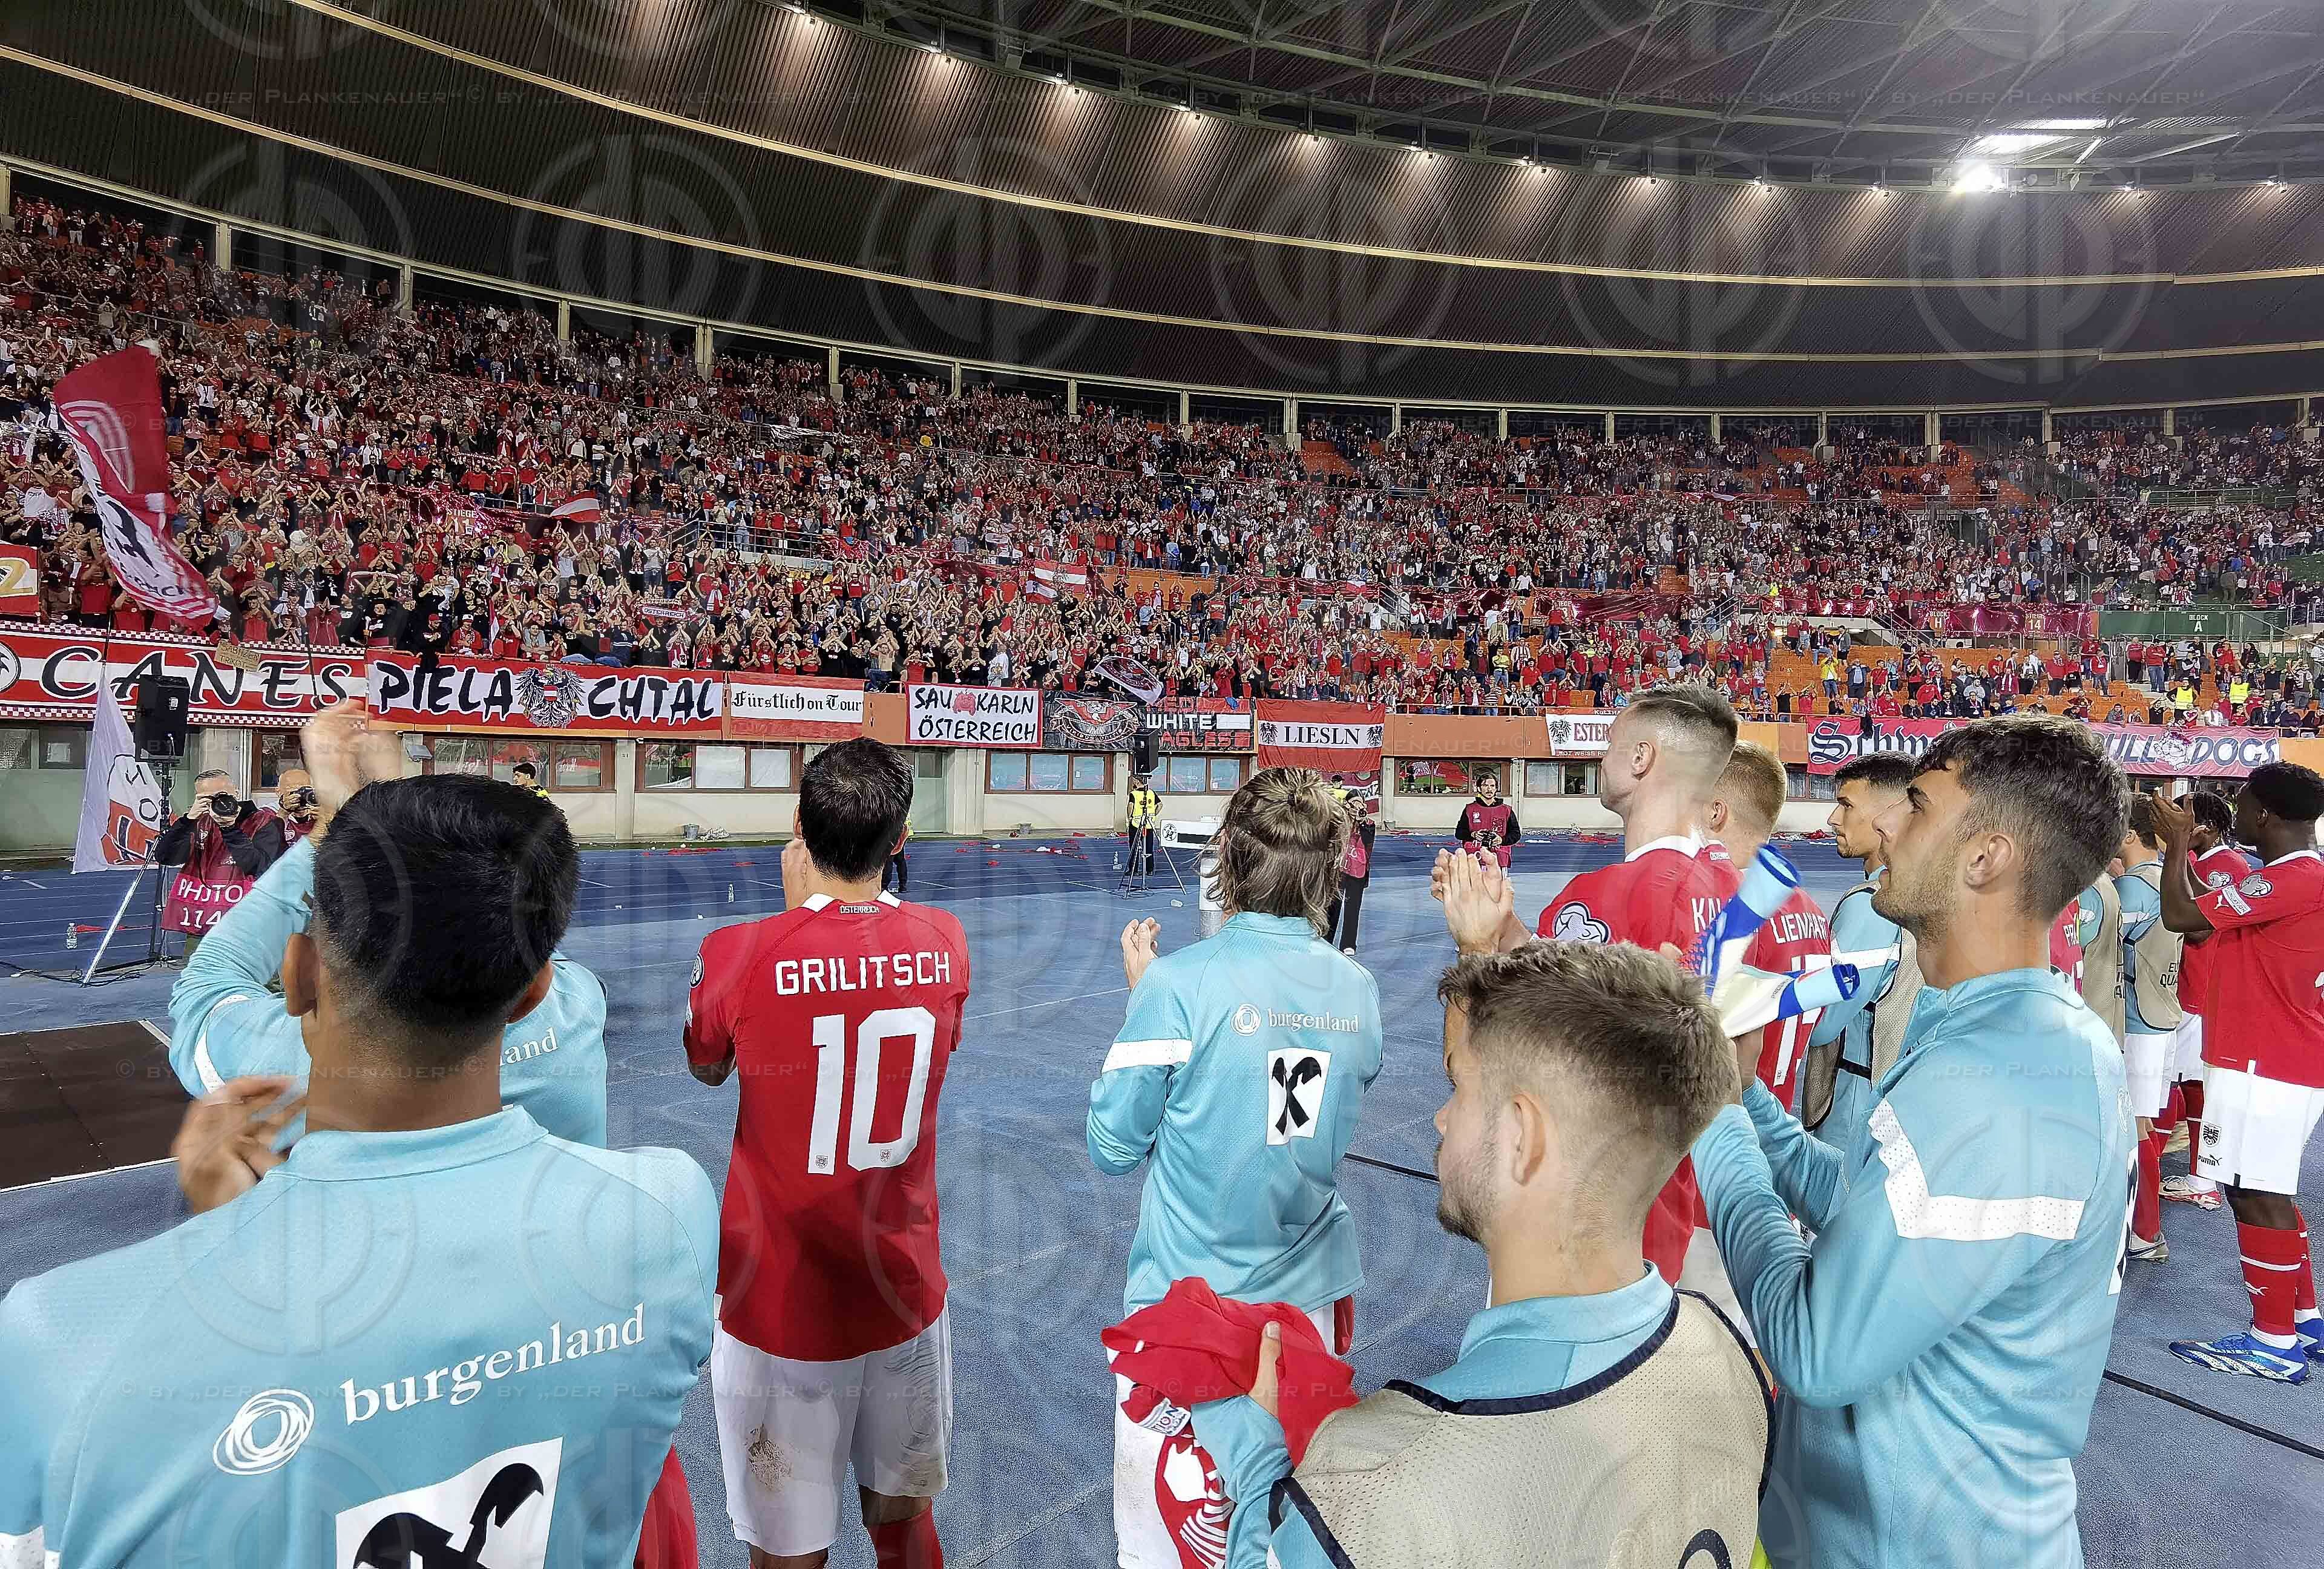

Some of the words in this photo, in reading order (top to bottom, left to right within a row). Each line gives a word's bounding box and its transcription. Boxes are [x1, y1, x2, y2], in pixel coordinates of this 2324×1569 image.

[1934, 618, 1942, 628] H
[2029, 619, 2041, 630] 14
[2194, 621, 2203, 633] A
[731, 689, 805, 712] Fürstlich
[807, 700, 824, 711] on
[826, 694, 862, 711] Tour
[914, 687, 953, 710] SAU
[917, 715, 1036, 743] ÖSTERREICH
[1146, 714, 1213, 730] WHITE
[1161, 731, 1231, 746] AGLES
[1284, 726, 1361, 745] LIESLN
[176, 878, 243, 903] PHOTO
[775, 951, 951, 995] GRILITSCH
[1267, 1007, 1360, 1033] burgenland
[807, 1005, 936, 1175] 10
[343, 1303, 646, 1425] burgenland
